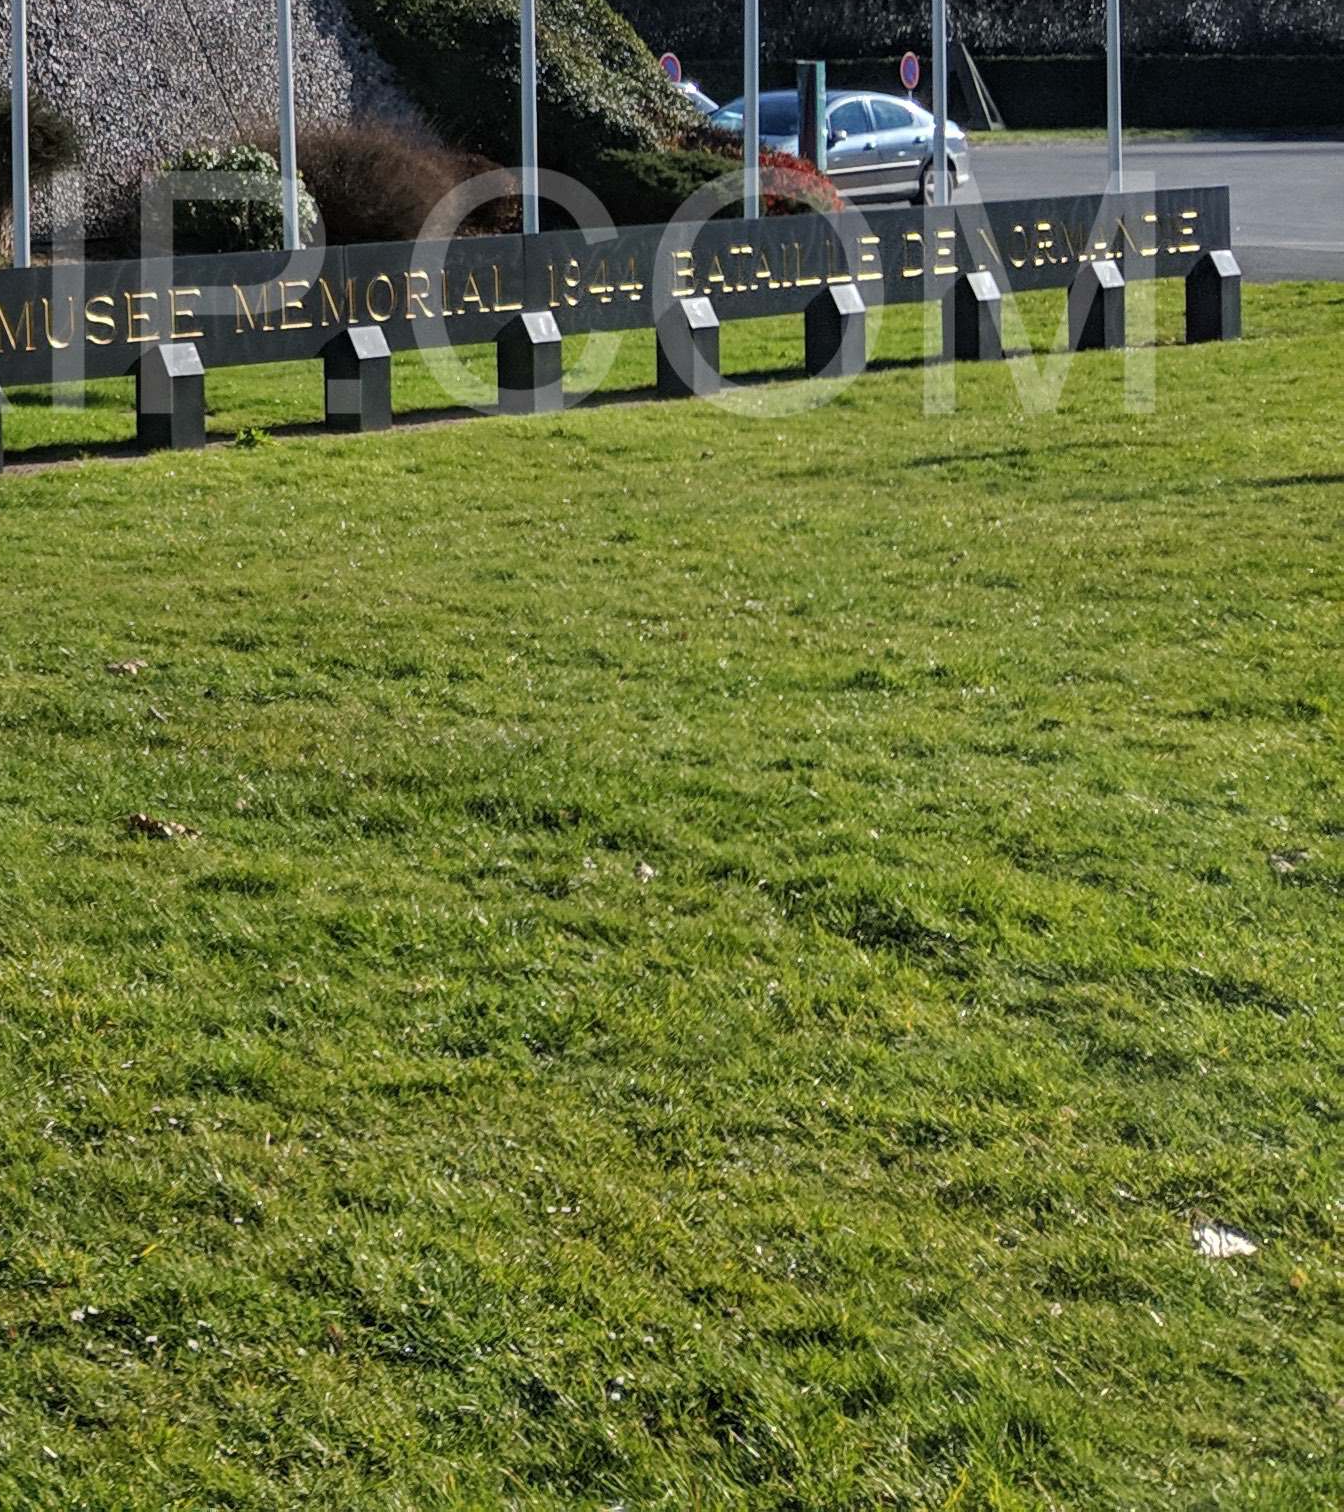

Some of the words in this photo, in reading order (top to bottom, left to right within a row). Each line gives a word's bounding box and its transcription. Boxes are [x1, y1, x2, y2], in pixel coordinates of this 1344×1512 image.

[232, 264, 525, 335] MEMORIAL
[548, 255, 645, 308] 1944
[671, 235, 885, 297] BATAILLE
[902, 230, 959, 278] DE
[975, 211, 1201, 271] NORMANDE
